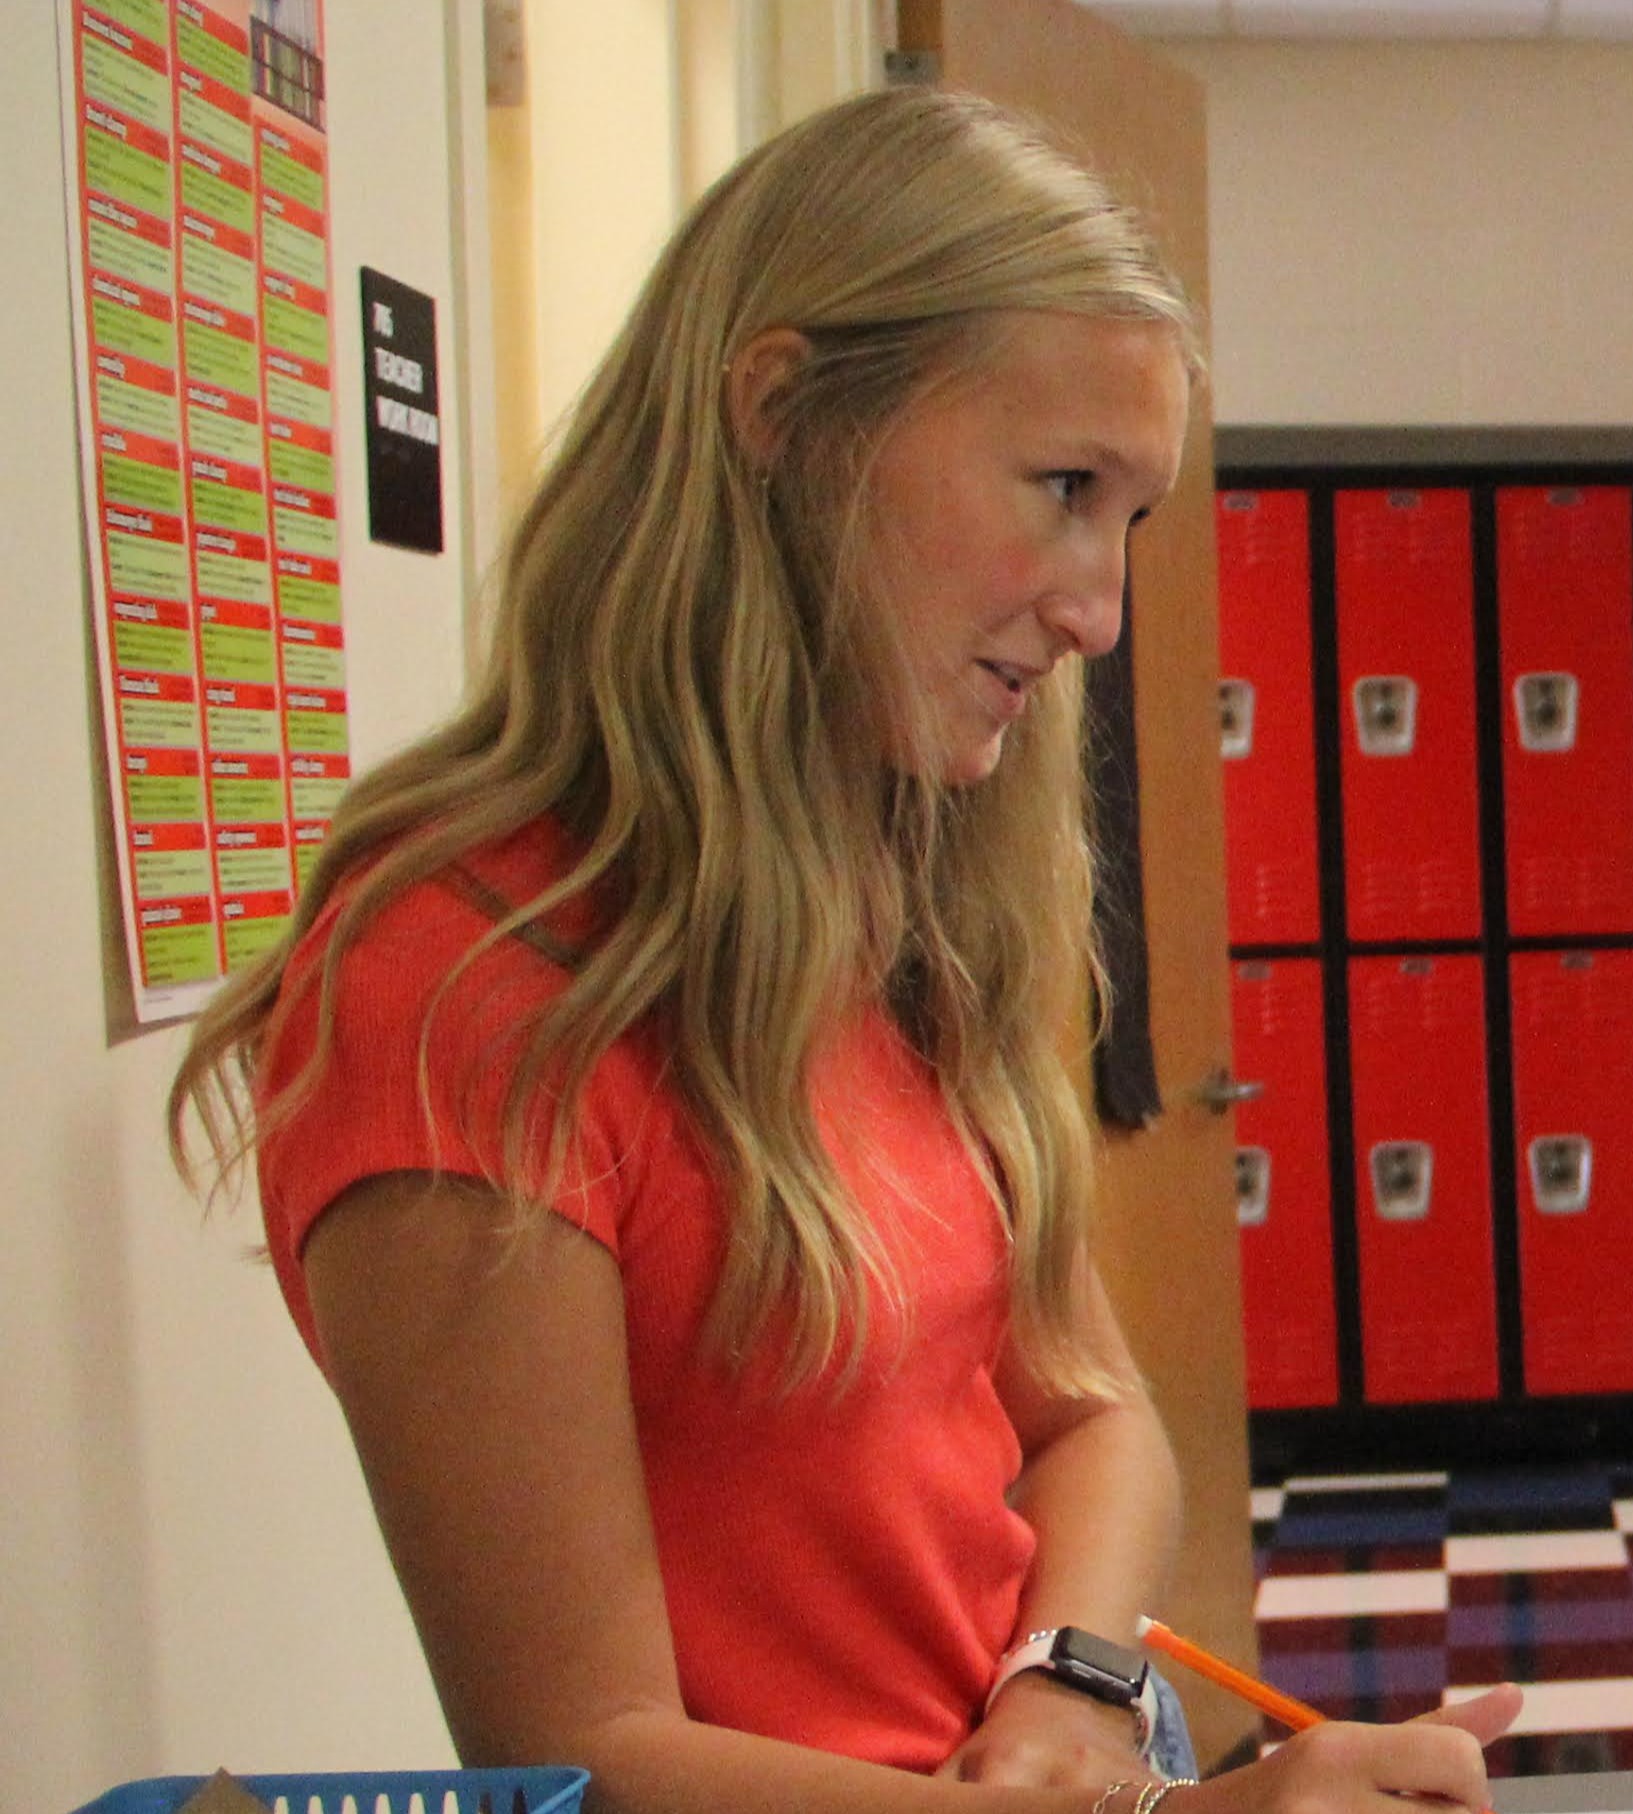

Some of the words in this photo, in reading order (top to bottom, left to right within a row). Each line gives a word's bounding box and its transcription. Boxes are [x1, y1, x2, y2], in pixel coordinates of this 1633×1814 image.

[374, 346, 424, 394] TEACHER
[375, 395, 409, 434] WORK
[408, 406, 440, 445] ROOM
